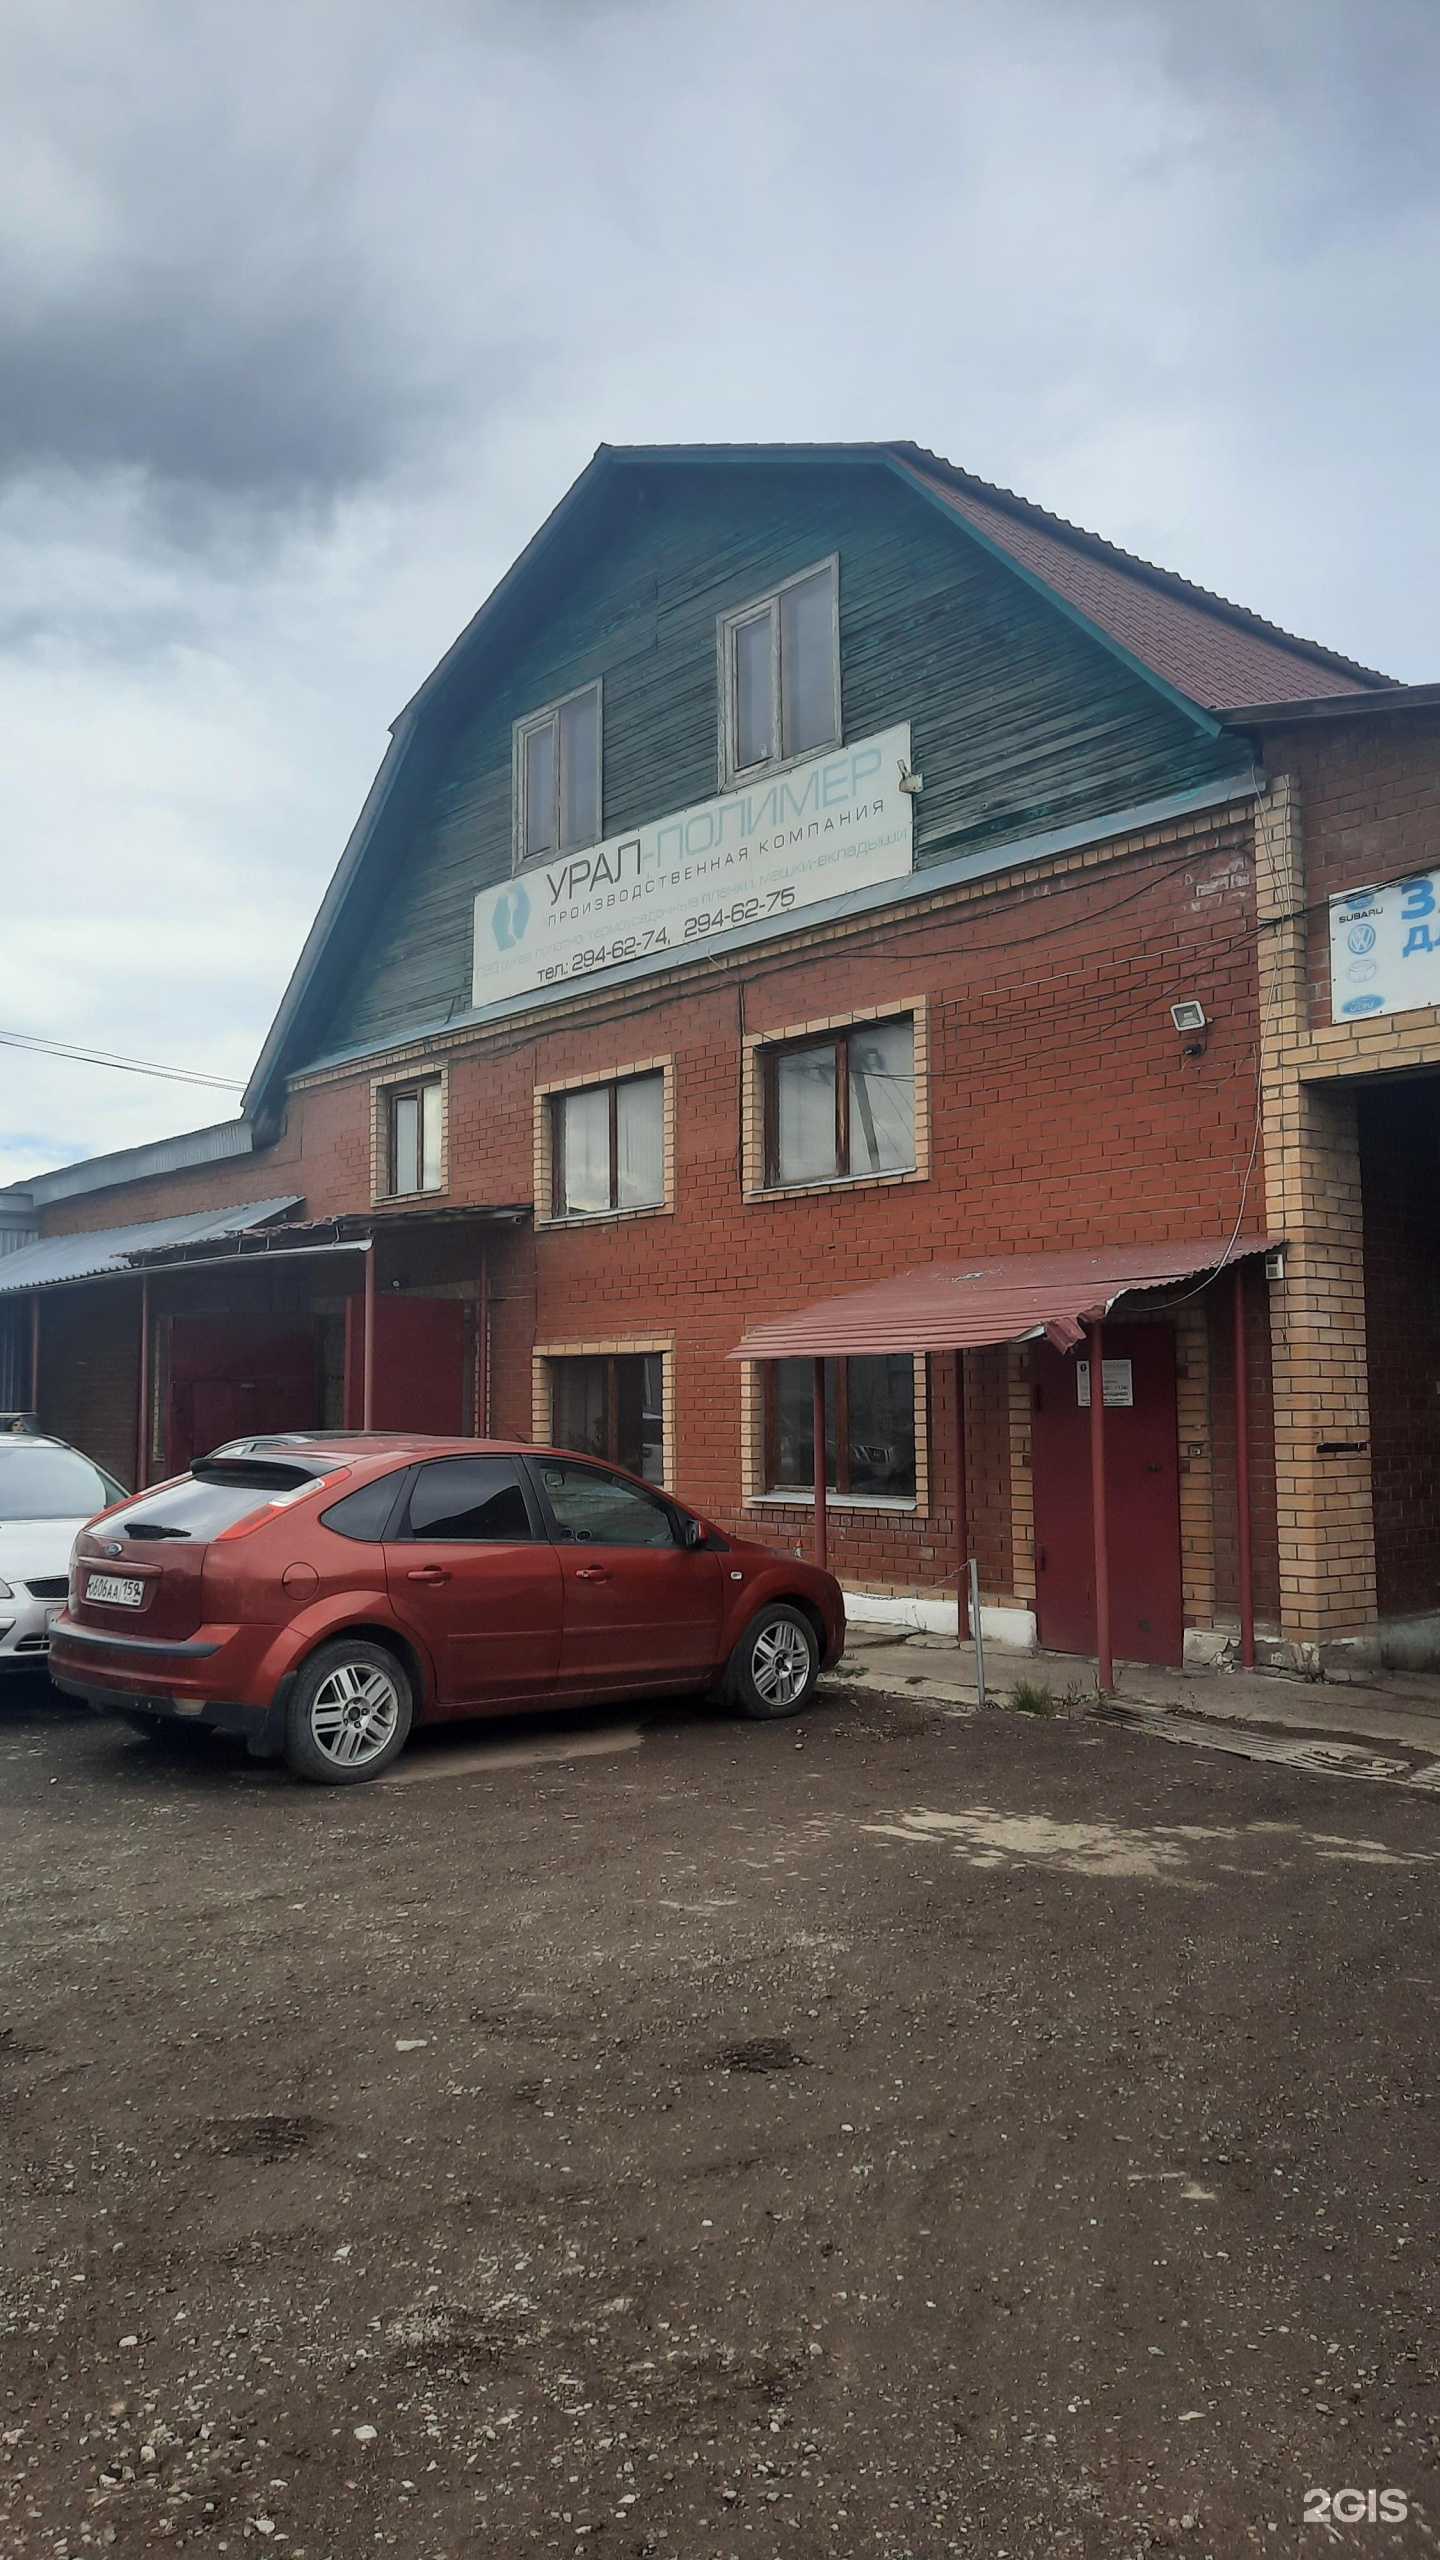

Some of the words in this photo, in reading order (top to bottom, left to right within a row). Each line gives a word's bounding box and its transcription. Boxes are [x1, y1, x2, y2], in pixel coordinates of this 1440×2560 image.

[546, 747, 882, 906] УРАЛ-ПОЛИМЕР
[547, 847, 749, 929] ПРОИЗВОДСТВЕННАЯ
[759, 799, 885, 854] КОМПАНИЯ
[684, 886, 796, 938] 294-62-75
[1338, 907, 1384, 924] SUBARU
[1401, 879, 1440, 920] З
[1402, 924, 1440, 958] Д
[123, 1581, 141, 1597] 159
